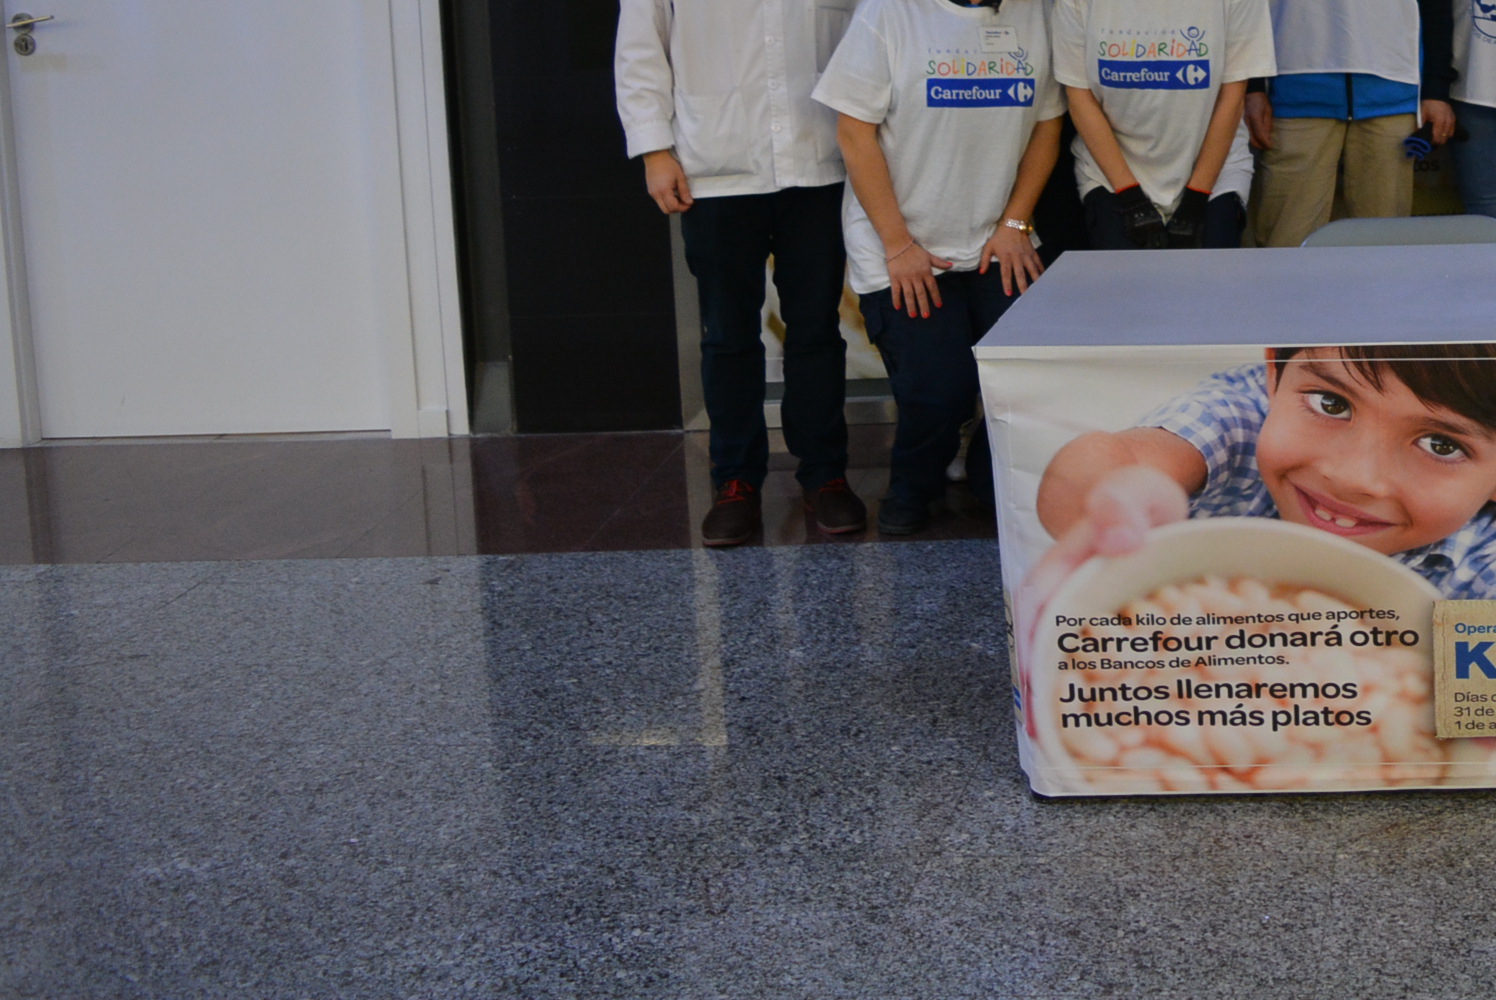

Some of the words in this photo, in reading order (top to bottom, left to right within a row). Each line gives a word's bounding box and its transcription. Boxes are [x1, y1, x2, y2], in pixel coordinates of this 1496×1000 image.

[1101, 67, 1170, 82] Carrefour
[930, 85, 1002, 100] Carrefour
[1055, 615, 1085, 627] Por
[1087, 613, 1132, 627] cada
[1135, 613, 1168, 627] kilo
[1169, 613, 1193, 626] de
[1195, 611, 1285, 625] alimentos
[1288, 612, 1323, 627] que
[1325, 607, 1401, 624] aportes,
[1057, 631, 1219, 654] Carrefour
[1225, 624, 1342, 649] donará
[1350, 625, 1420, 648] otro
[1057, 661, 1069, 671] a
[1071, 658, 1097, 671] los
[1100, 657, 1165, 670] Bancos
[1168, 656, 1191, 669] de
[1194, 653, 1290, 668] Alimentos.
[1059, 682, 1170, 704] Juntos
[1176, 678, 1358, 701] llenaremos
[1454, 690, 1488, 703] Días
[1061, 705, 1190, 729] muchos
[1197, 703, 1264, 728] más
[1271, 704, 1373, 731] platos
[1454, 706, 1474, 717] 31
[1476, 705, 1495, 717] de
[1455, 721, 1462, 730] 1
[1464, 720, 1484, 730] de
